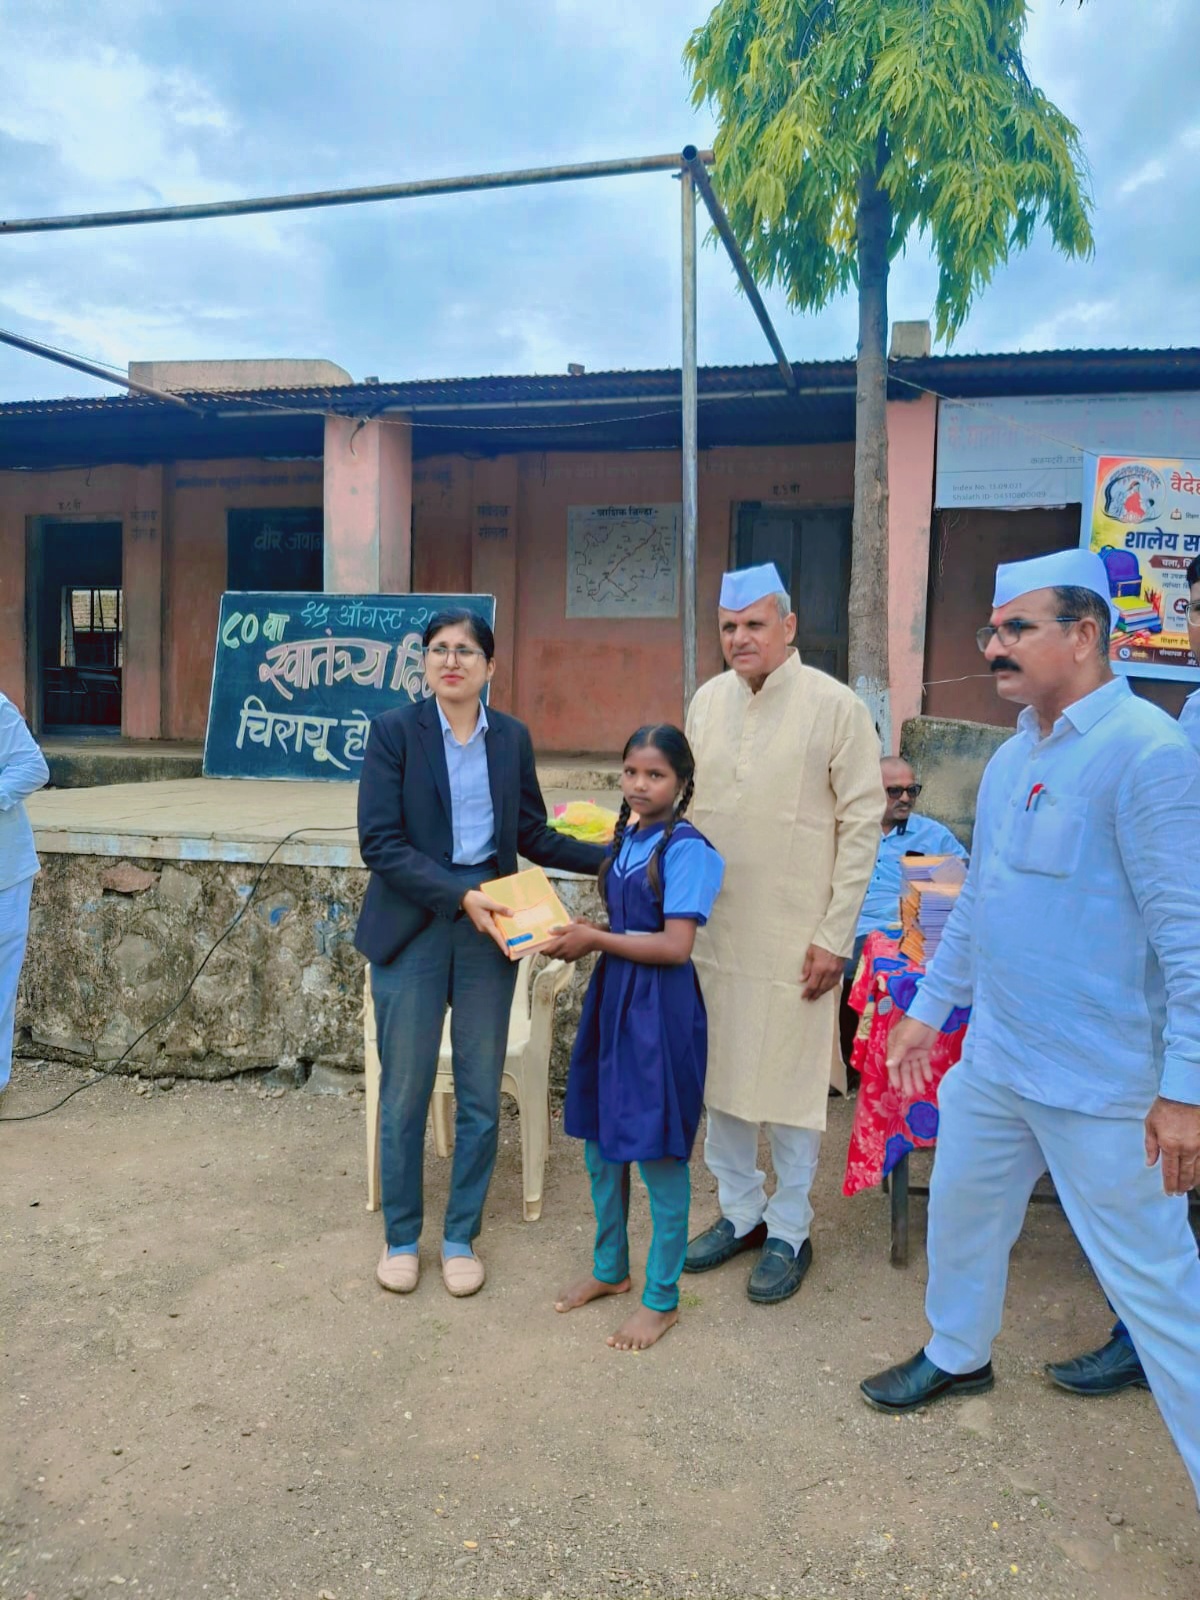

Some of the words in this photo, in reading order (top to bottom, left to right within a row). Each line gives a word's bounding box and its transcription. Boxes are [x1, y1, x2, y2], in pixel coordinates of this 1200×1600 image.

[952, 483, 973, 492] Index
[1125, 526, 1180, 551] शालेय
[336, 601, 406, 634] ऑगस्ट
[236, 695, 351, 771] चिरायू
